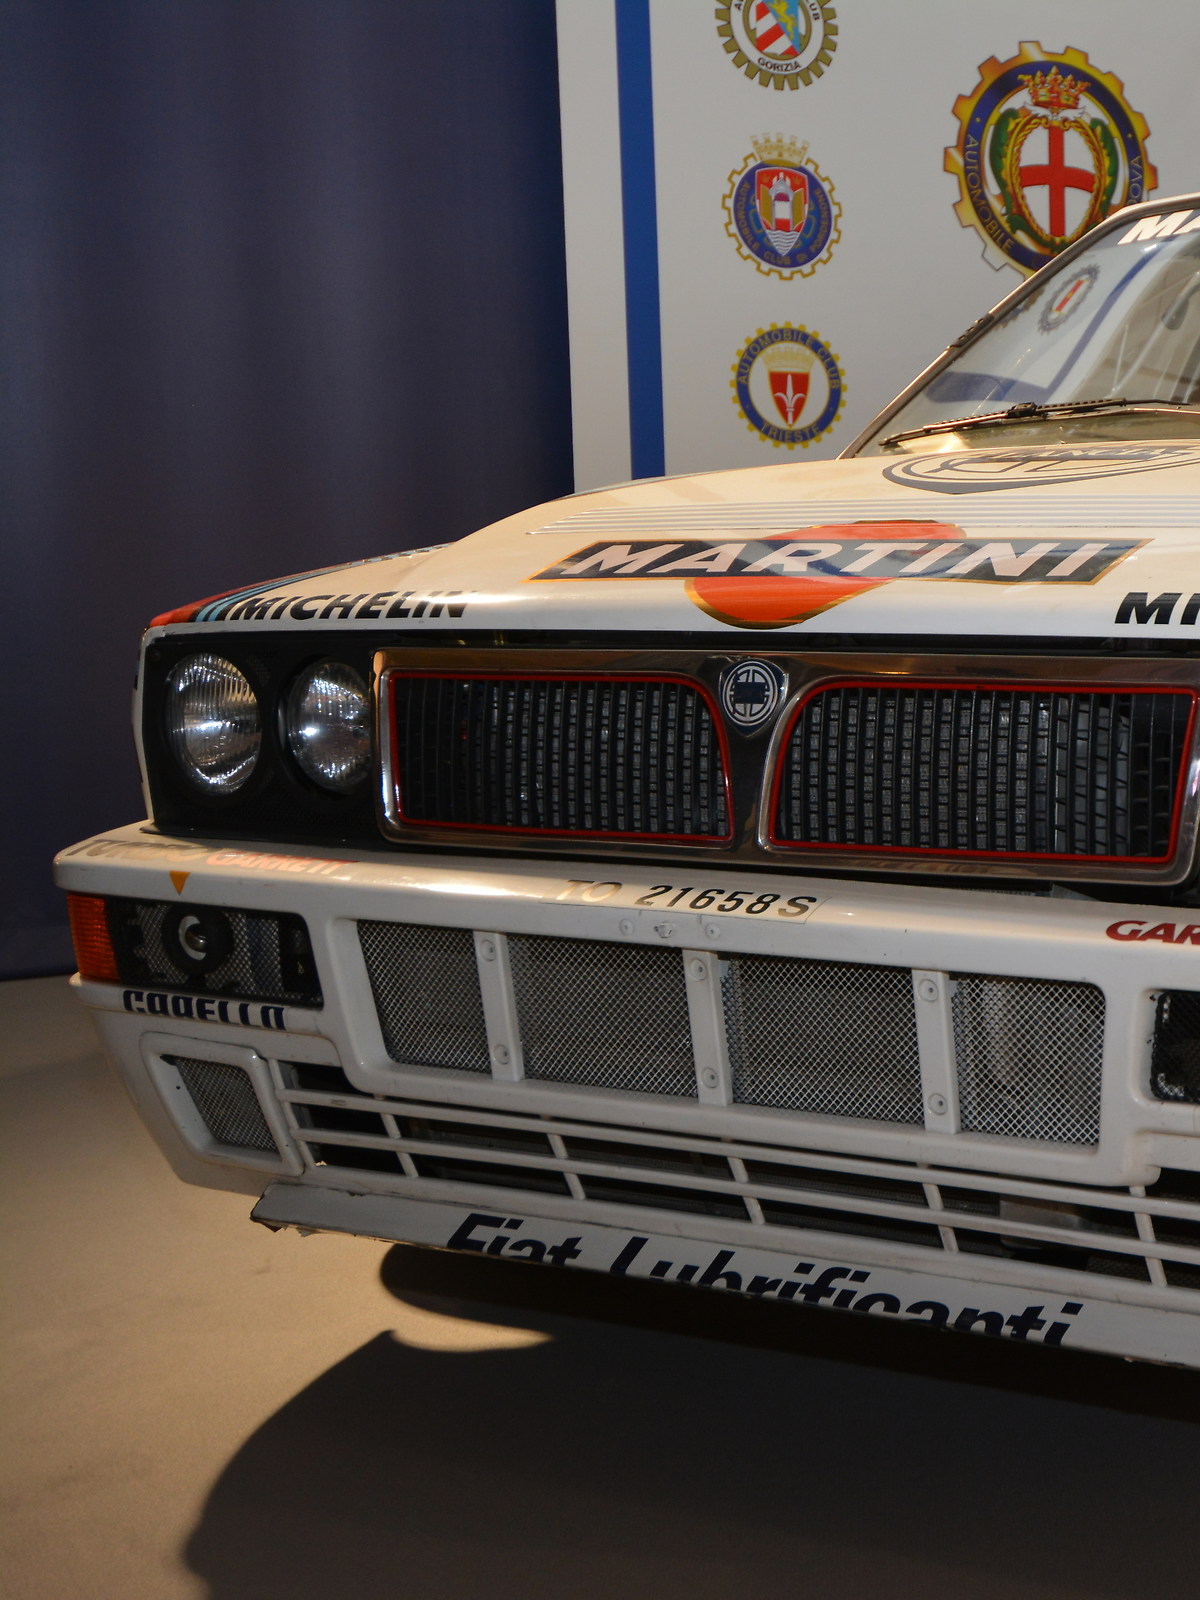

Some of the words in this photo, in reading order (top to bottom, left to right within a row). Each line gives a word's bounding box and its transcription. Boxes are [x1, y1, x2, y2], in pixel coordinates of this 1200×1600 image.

[757, 57, 801, 72] GORIZIA
[963, 132, 1015, 254] AUTOMOBILE
[737, 328, 815, 385] AUTOMOBILE
[817, 347, 840, 389] CLUB
[760, 423, 821, 442] TRIESTE
[560, 542, 1110, 577] MARTINI
[229, 590, 479, 621] MICHELIN
[206, 851, 360, 874] GARRETT
[556, 879, 623, 902] TO
[634, 885, 818, 918] 21658S
[122, 989, 287, 1031] CARELLO
